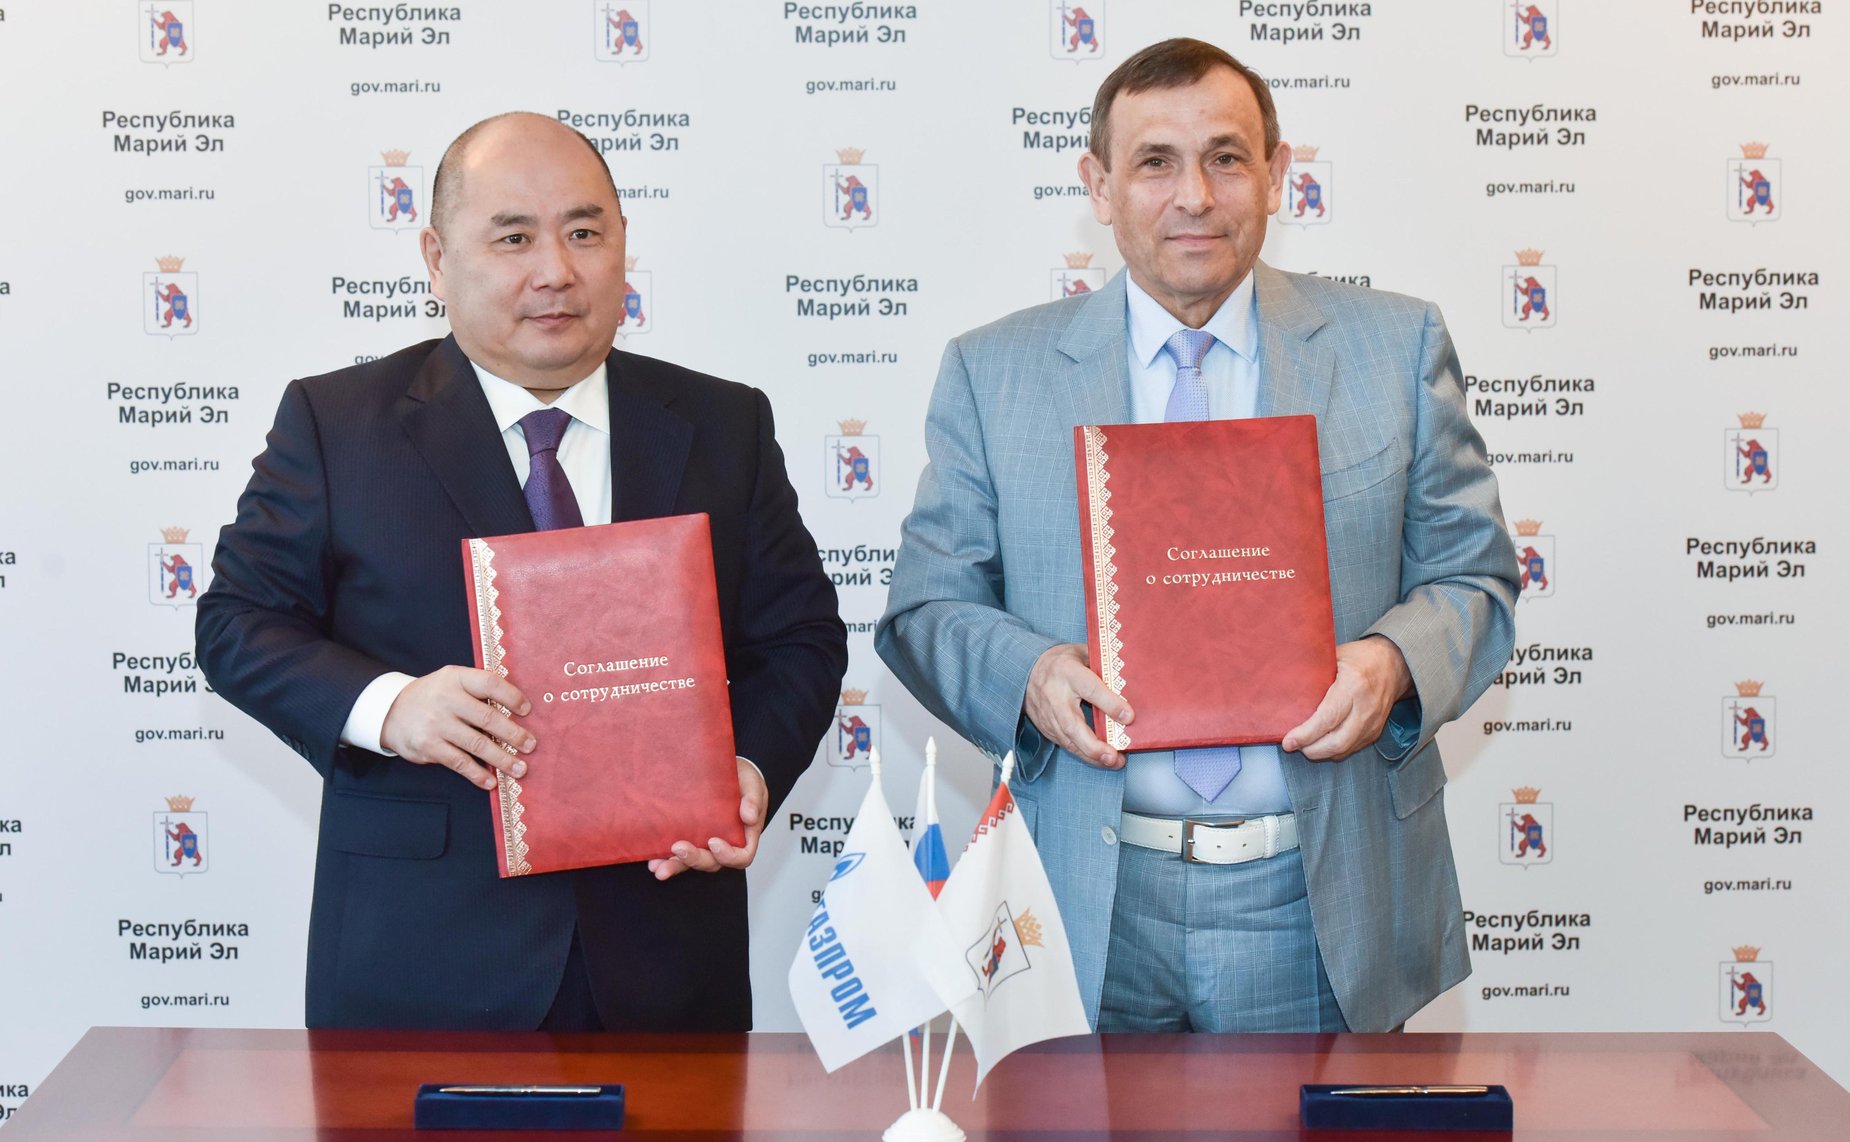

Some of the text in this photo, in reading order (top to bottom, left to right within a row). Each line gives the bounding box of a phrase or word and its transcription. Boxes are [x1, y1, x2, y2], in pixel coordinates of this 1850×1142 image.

[328, 2, 462, 26] Республика
[784, 0, 917, 25] Республика
[1239, 0, 1372, 22] Республика
[1691, 0, 1822, 19] Республика
[339, 26, 450, 50] Марий Эл
[795, 24, 906, 48] Марий Эл
[1250, 22, 1361, 46] Марий Эл
[1701, 19, 1811, 43] Марий Эл
[350, 79, 441, 97] gov.mari.ru
[806, 77, 896, 95] gov.mari.ru
[1711, 72, 1801, 90] gov.mari.ru
[102, 110, 235, 134] Республика
[557, 109, 690, 132] Республика
[1012, 106, 1092, 129] Респуб
[1465, 103, 1597, 127] Республика
[113, 133, 224, 157] Марий Эл
[649, 132, 679, 151] Эл
[1476, 127, 1586, 151] Марий Эл
[124, 186, 215, 204] gov.mari.ru
[617, 185, 669, 199] mari.ru
[1485, 180, 1575, 197] gov.mari.ru
[331, 276, 432, 299] Республ
[785, 274, 919, 300] Республика
[1688, 267, 1820, 292] Республика
[343, 300, 417, 323] Марий
[797, 297, 907, 321] Марий Эл
[1699, 291, 1808, 315] Марий Эл
[807, 350, 898, 368] gov.mari.ru
[1708, 343, 1798, 361] gov.mari.ru
[107, 381, 240, 405] Республика
[1464, 375, 1595, 398] Республика
[118, 405, 229, 429] Марий Эл
[1474, 397, 1584, 421] Марий Эл
[129, 457, 220, 475] gov.mari.ru
[1486, 450, 1574, 467] gov.mari.ru
[1166, 546, 1271, 561] Соглашение
[1686, 536, 1817, 560] Республика
[1145, 568, 1296, 587] о сотрудничестве
[1696, 559, 1806, 583] Марий Эл
[1706, 611, 1795, 629] gov.mari.ru
[112, 651, 198, 674] Респуб
[563, 655, 669, 676] Соглашение
[1511, 643, 1594, 666] ублика
[123, 675, 197, 698] Марий
[1492, 666, 1582, 690] арий Эл
[543, 677, 696, 703] о сотрудничестве
[134, 726, 225, 744] gov.mari.ru
[1482, 717, 1572, 736] gov.mari.ru
[1683, 803, 1814, 828] Республика
[1694, 825, 1803, 849] Марий Эл
[1703, 877, 1792, 895] gov.mari.ru
[118, 918, 249, 942] Республика
[1463, 910, 1591, 933] Республика
[129, 941, 239, 965] Марий Эл
[1472, 932, 1580, 955] Марий Эл
[140, 992, 230, 1010] gov.mari.ru
[1481, 983, 1570, 1001] gov.mari.ru
